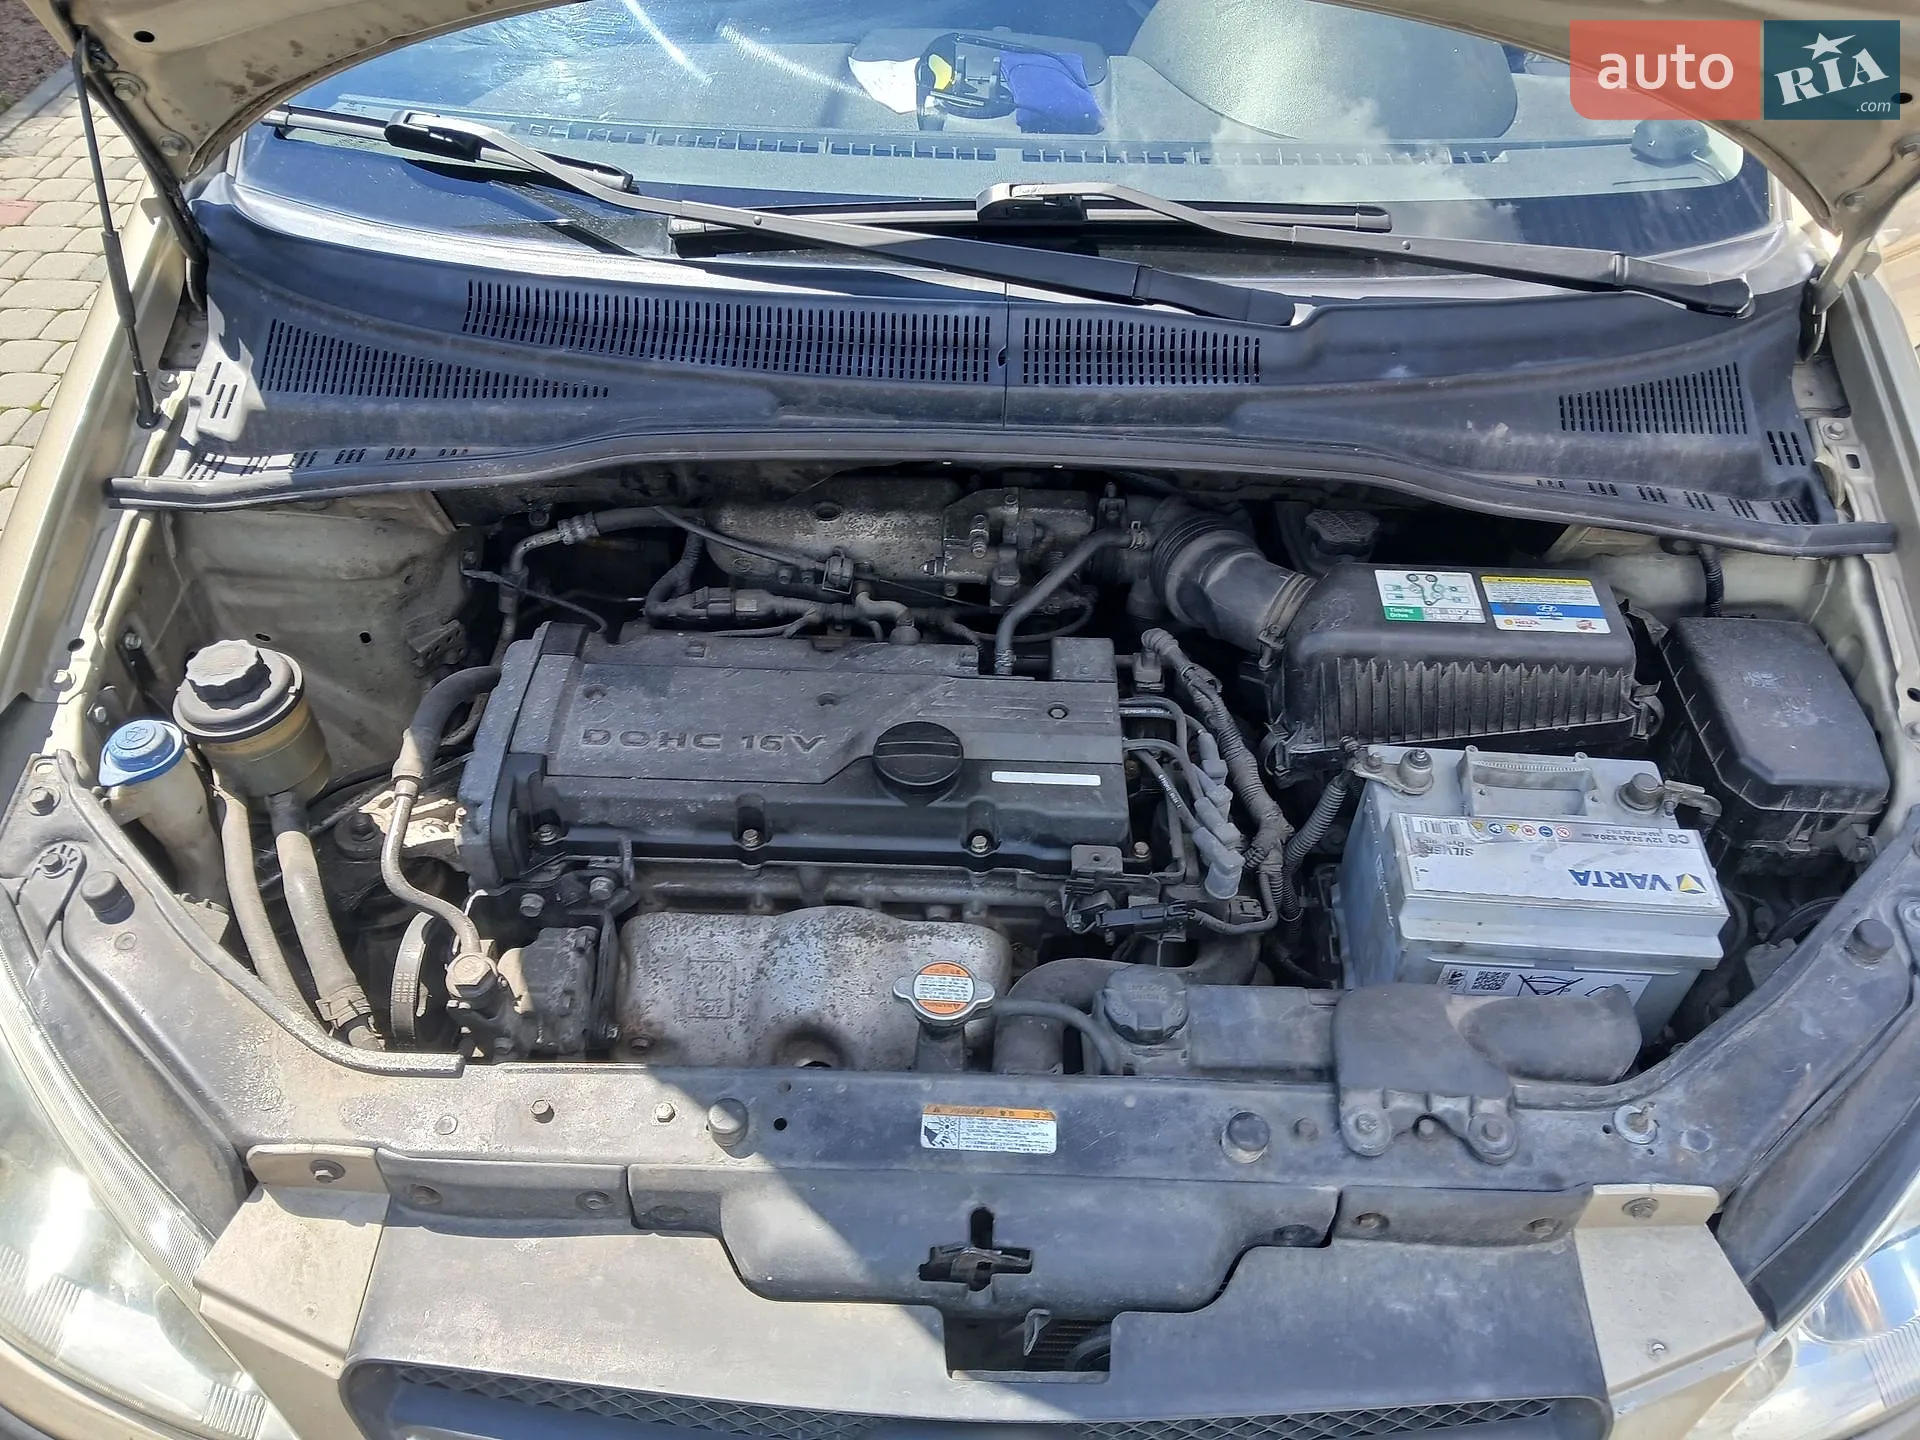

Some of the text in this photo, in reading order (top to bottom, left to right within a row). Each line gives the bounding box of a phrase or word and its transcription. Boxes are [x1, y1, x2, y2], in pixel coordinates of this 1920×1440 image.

[580, 727, 826, 753] DOHC 16V
[1568, 869, 1673, 892] VARTA
